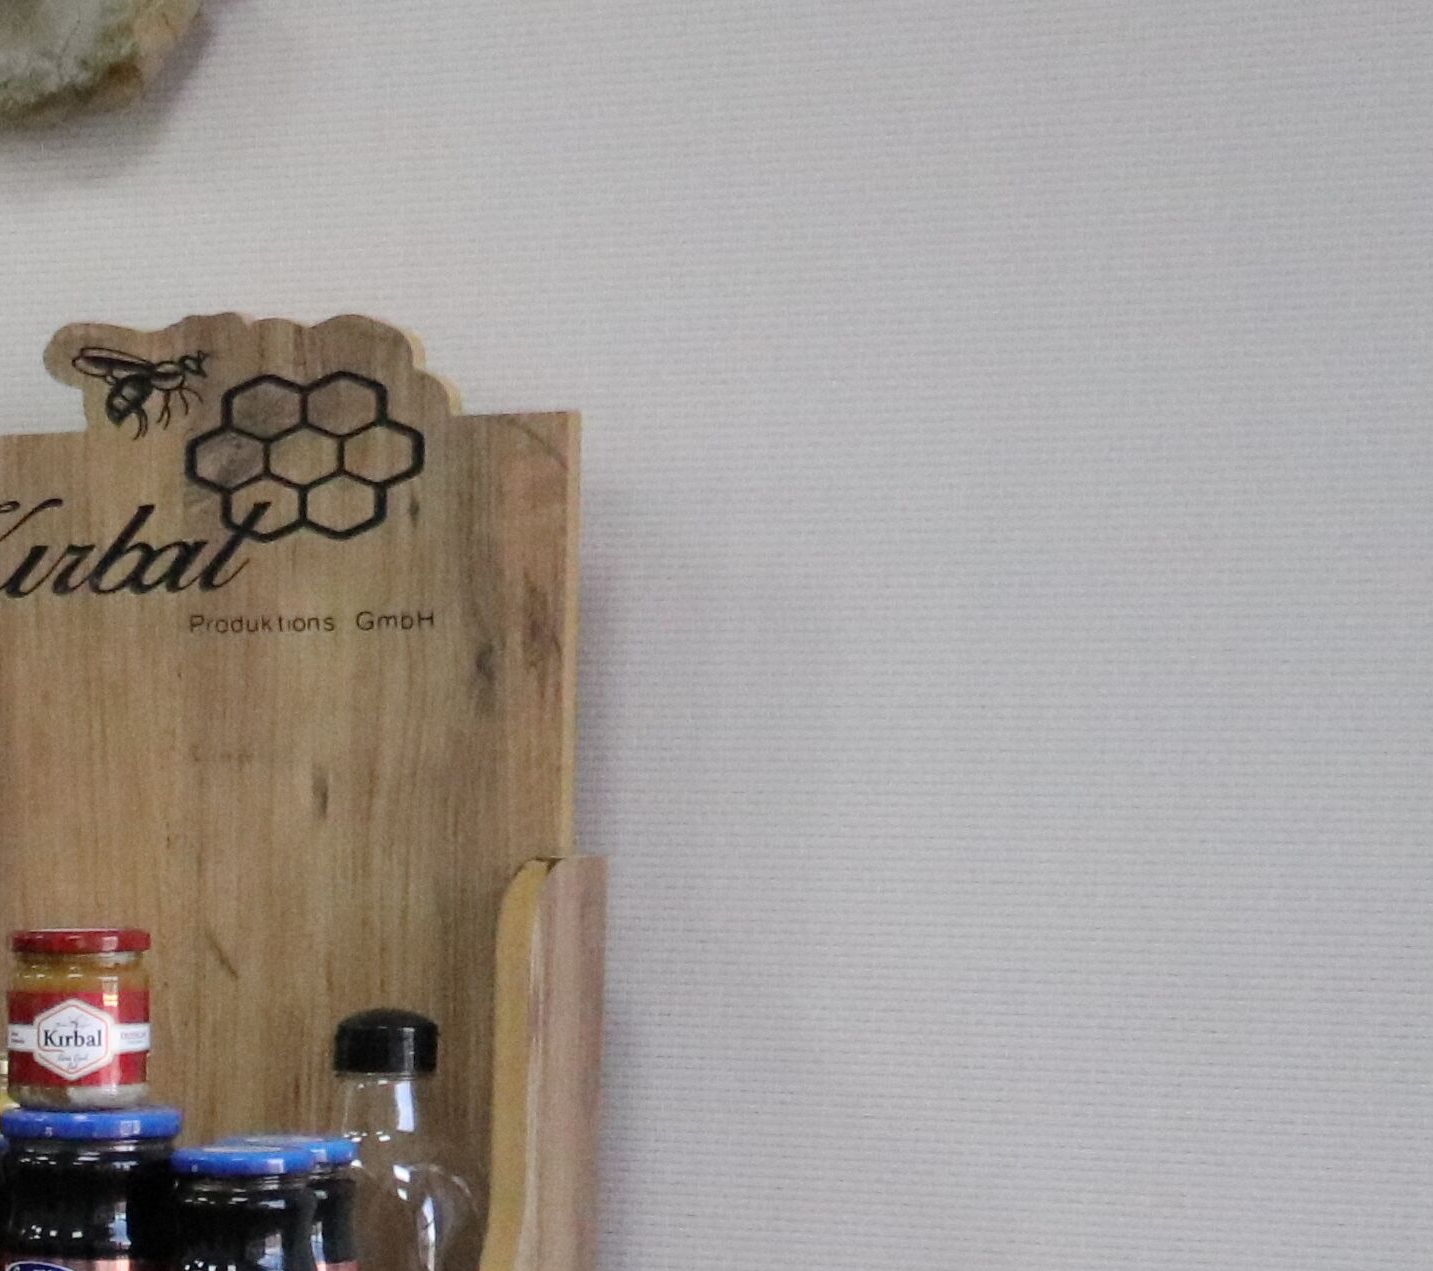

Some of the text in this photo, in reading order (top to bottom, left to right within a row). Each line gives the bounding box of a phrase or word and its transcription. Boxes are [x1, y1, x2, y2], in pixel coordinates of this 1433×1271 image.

[189, 609, 435, 634] Produktions GmbH
[43, 1028, 103, 1048] Kırbal
